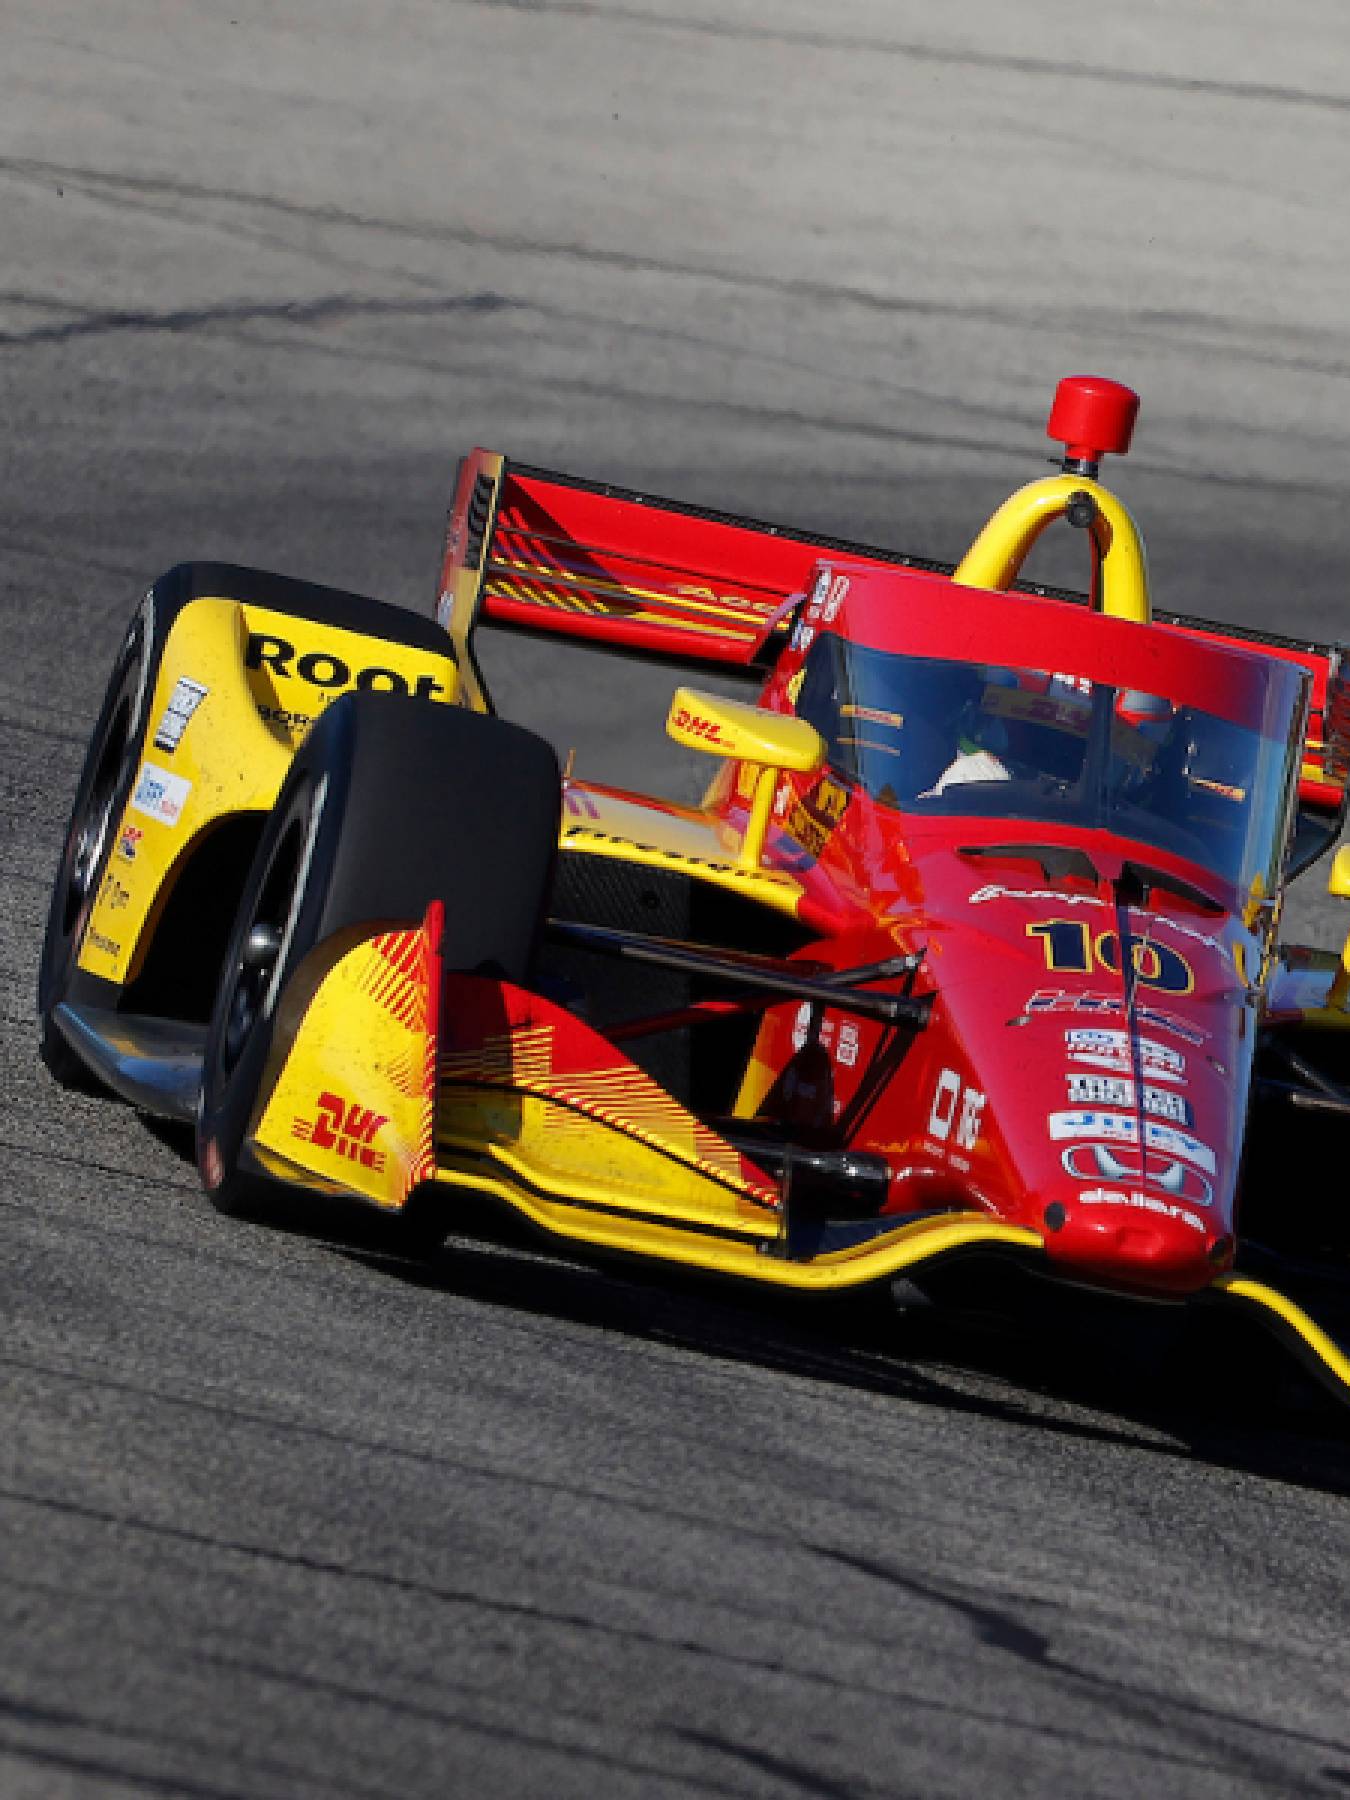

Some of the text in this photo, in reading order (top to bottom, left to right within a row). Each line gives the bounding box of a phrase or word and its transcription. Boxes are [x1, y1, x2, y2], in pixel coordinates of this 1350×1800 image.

[671, 709, 736, 750] DHL
[1025, 919, 1195, 995] 10
[309, 1091, 390, 1168] DHL
